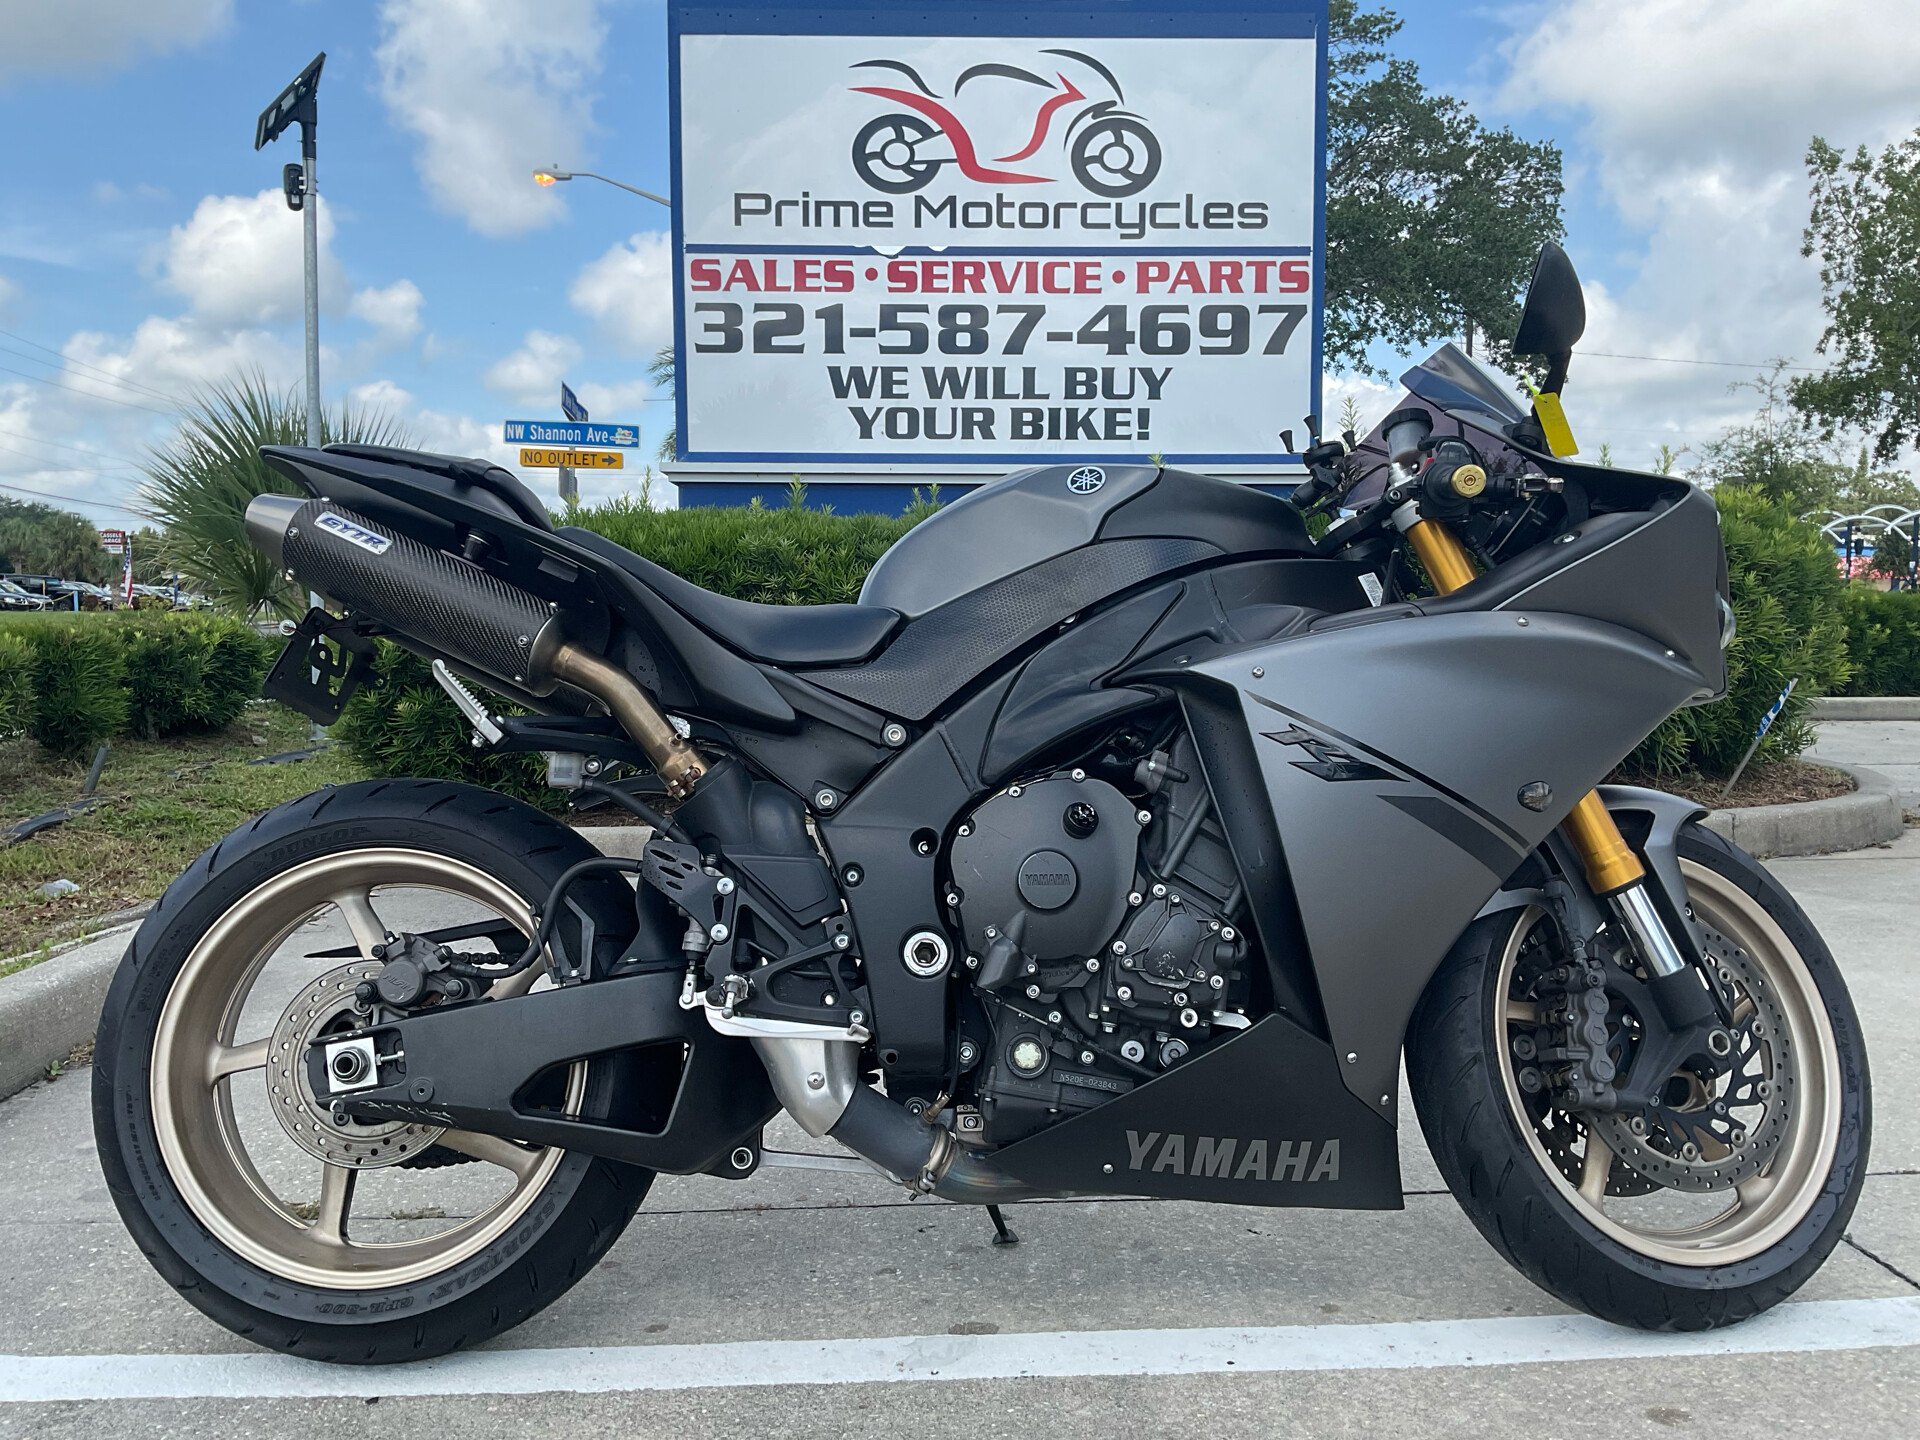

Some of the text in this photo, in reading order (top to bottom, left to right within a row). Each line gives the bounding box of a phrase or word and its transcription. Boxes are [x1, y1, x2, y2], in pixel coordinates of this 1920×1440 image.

[733, 192, 1269, 240] Prime Motorcycles
[690, 258, 1311, 295] SALES SERVICE PARTS
[693, 302, 1309, 356] 321-587-4697
[826, 365, 1173, 401] WE WILL BUY
[506, 425, 525, 440] NW
[530, 424, 581, 442] Shannon
[586, 427, 609, 443] Ave
[848, 406, 1151, 442] YOUR BIKE!
[524, 452, 598, 466] NO OUTLET
[320, 517, 387, 549] GYTR
[1025, 873, 1071, 886] YAMAHA
[1125, 1129, 1340, 1182] YAMAHA
